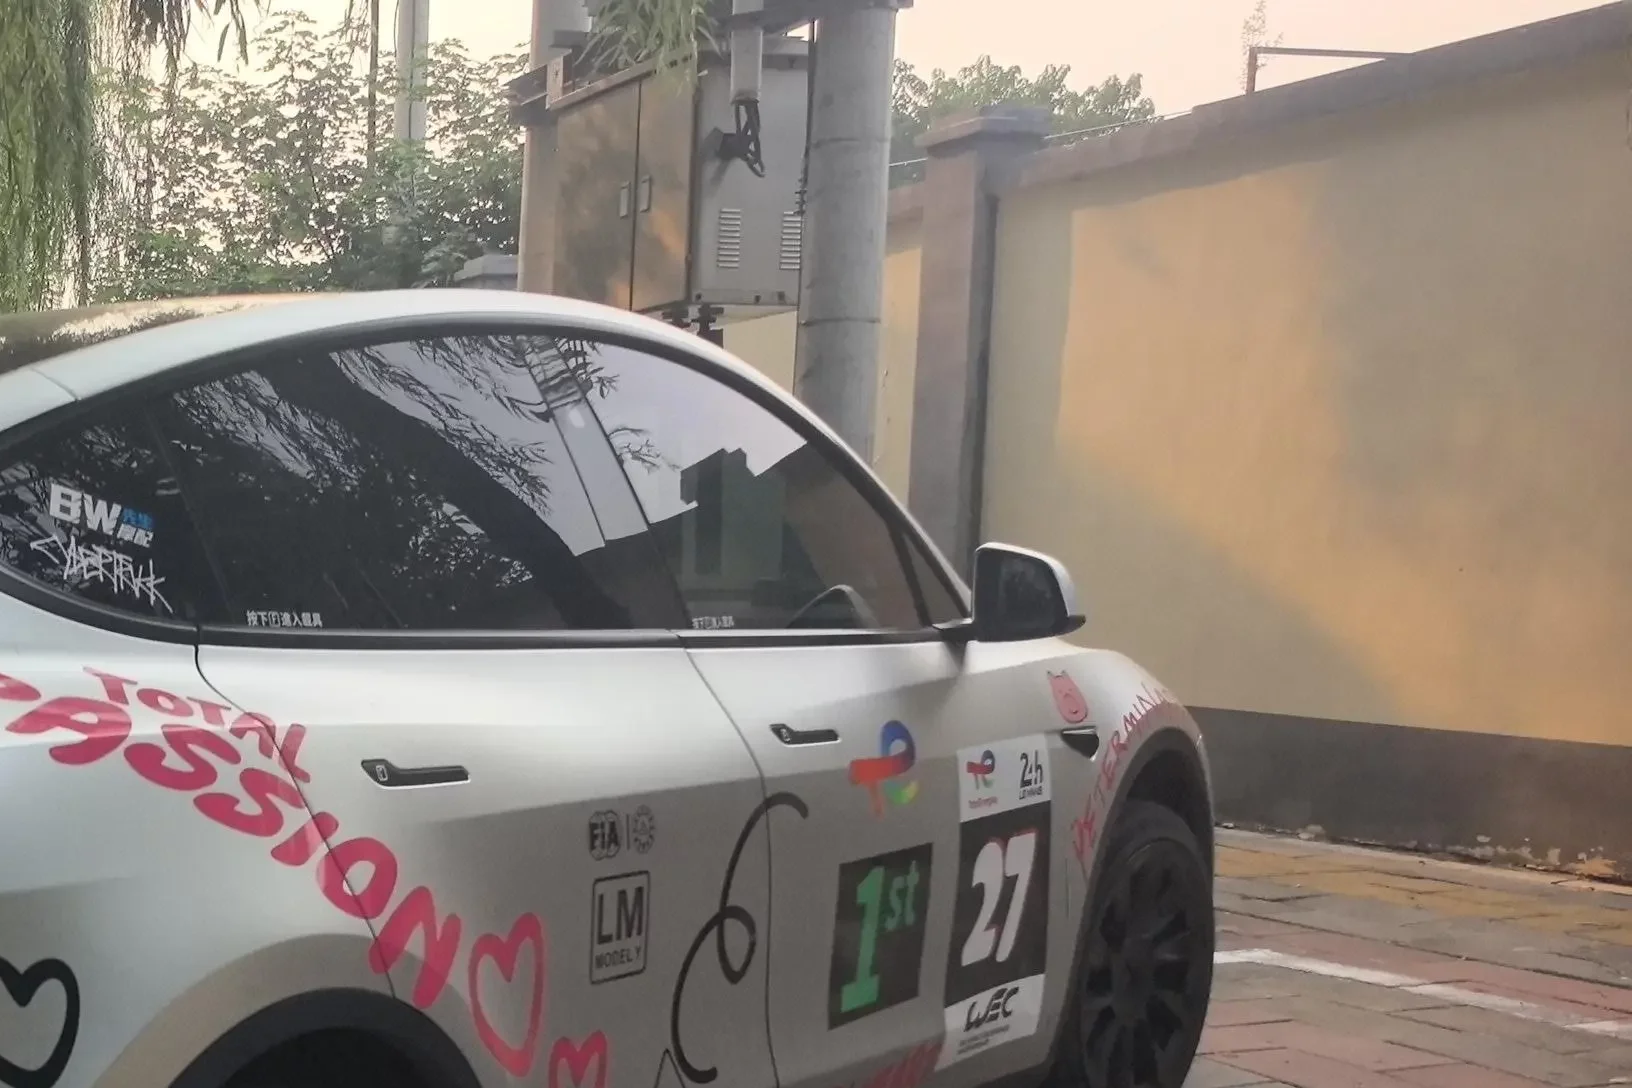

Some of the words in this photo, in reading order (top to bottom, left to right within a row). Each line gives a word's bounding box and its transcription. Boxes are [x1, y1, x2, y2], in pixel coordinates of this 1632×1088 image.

[50, 483, 122, 535] BW
[82, 666, 312, 784] TOTAL
[589, 820, 619, 851] FIA
[597, 886, 645, 945] LM
[961, 832, 1036, 967] 27
